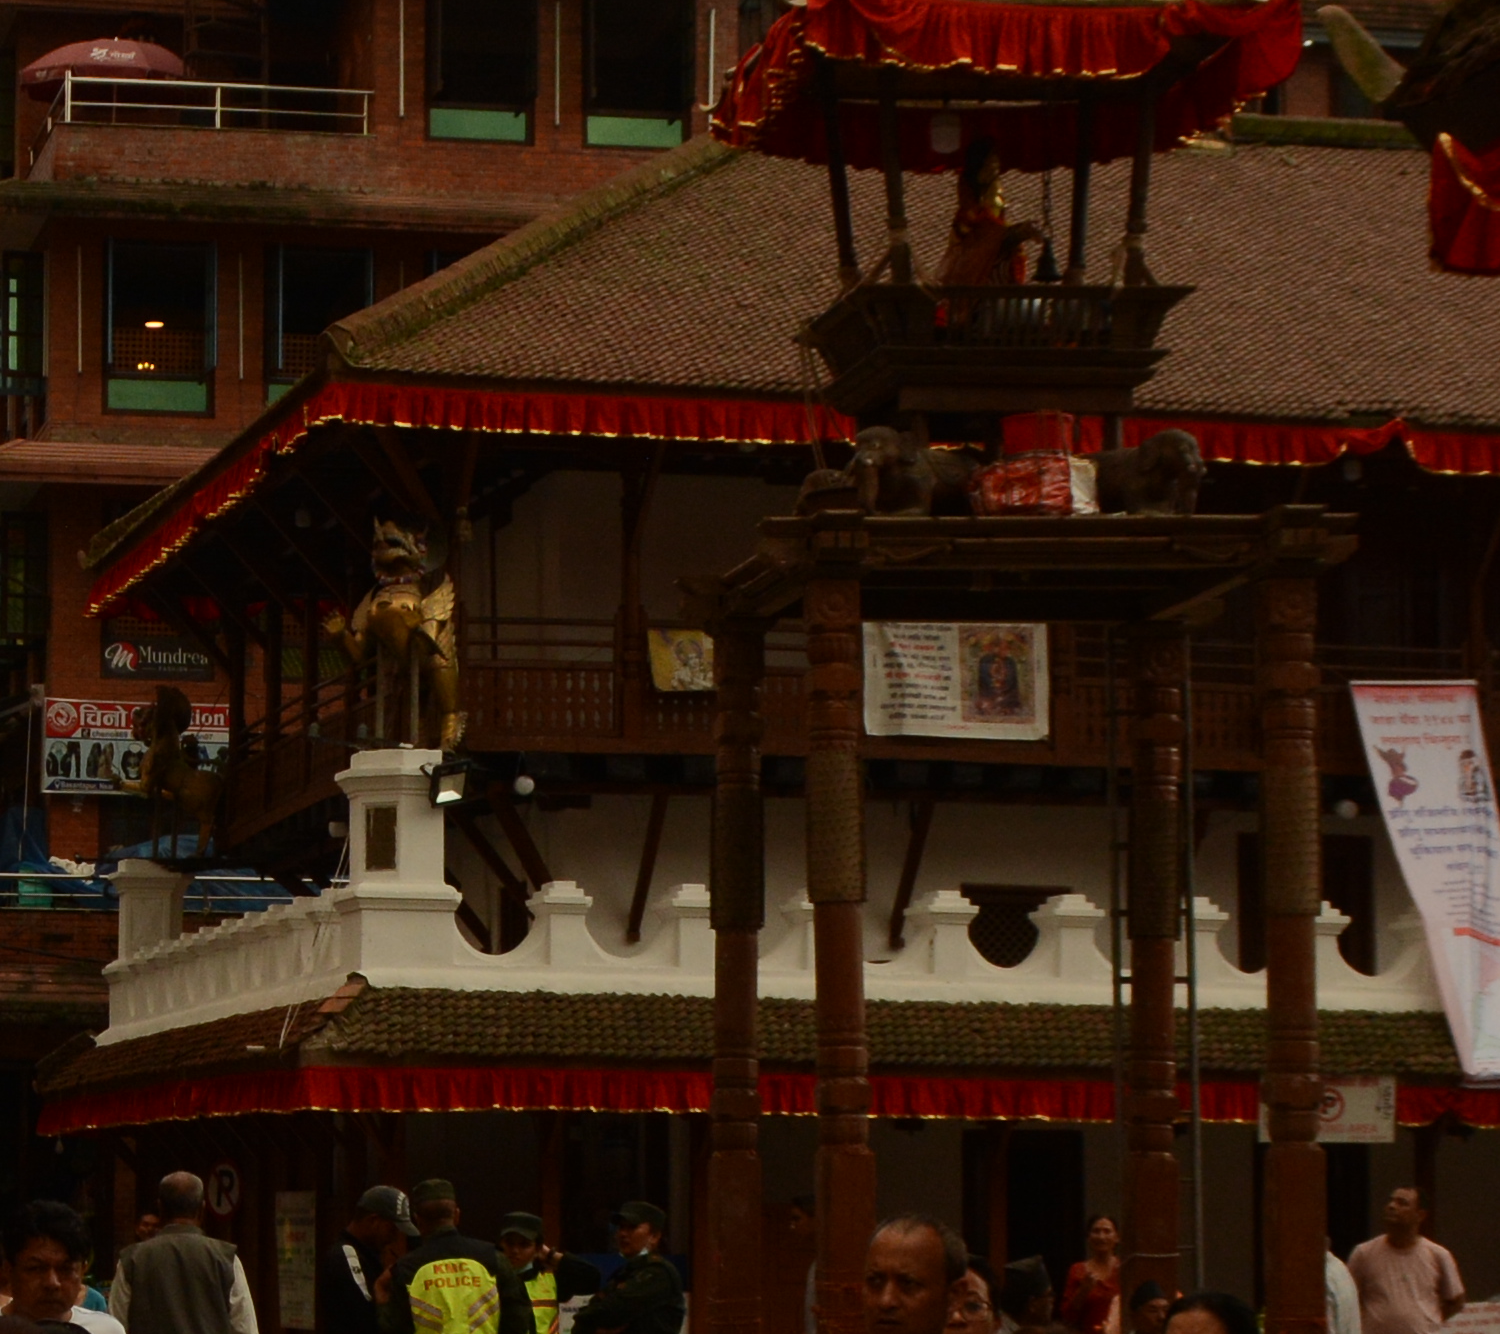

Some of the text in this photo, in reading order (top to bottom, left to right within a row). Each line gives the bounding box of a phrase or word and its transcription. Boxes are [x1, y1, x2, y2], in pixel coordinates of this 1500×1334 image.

[79, 704, 129, 728] चिनो
[433, 1262, 470, 1275] KMC
[423, 1276, 482, 1291] POLICE
